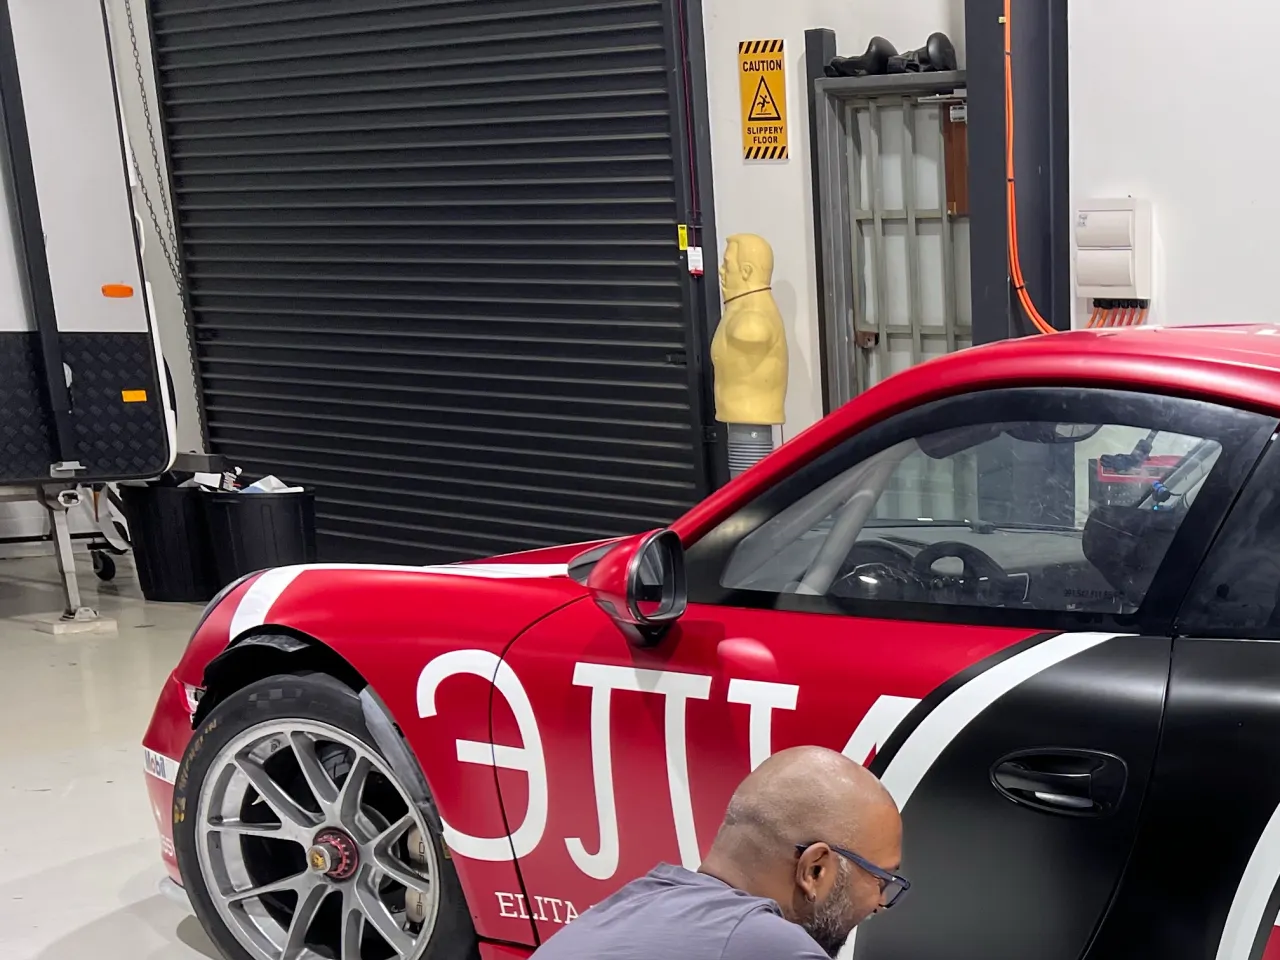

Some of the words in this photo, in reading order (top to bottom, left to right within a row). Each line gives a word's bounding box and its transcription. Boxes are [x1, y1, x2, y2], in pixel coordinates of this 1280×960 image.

[743, 60, 782, 72] CAUTION
[747, 126, 784, 135] SLIPPERY
[753, 136, 778, 144] FLOOR
[494, 891, 579, 925] ELITA
